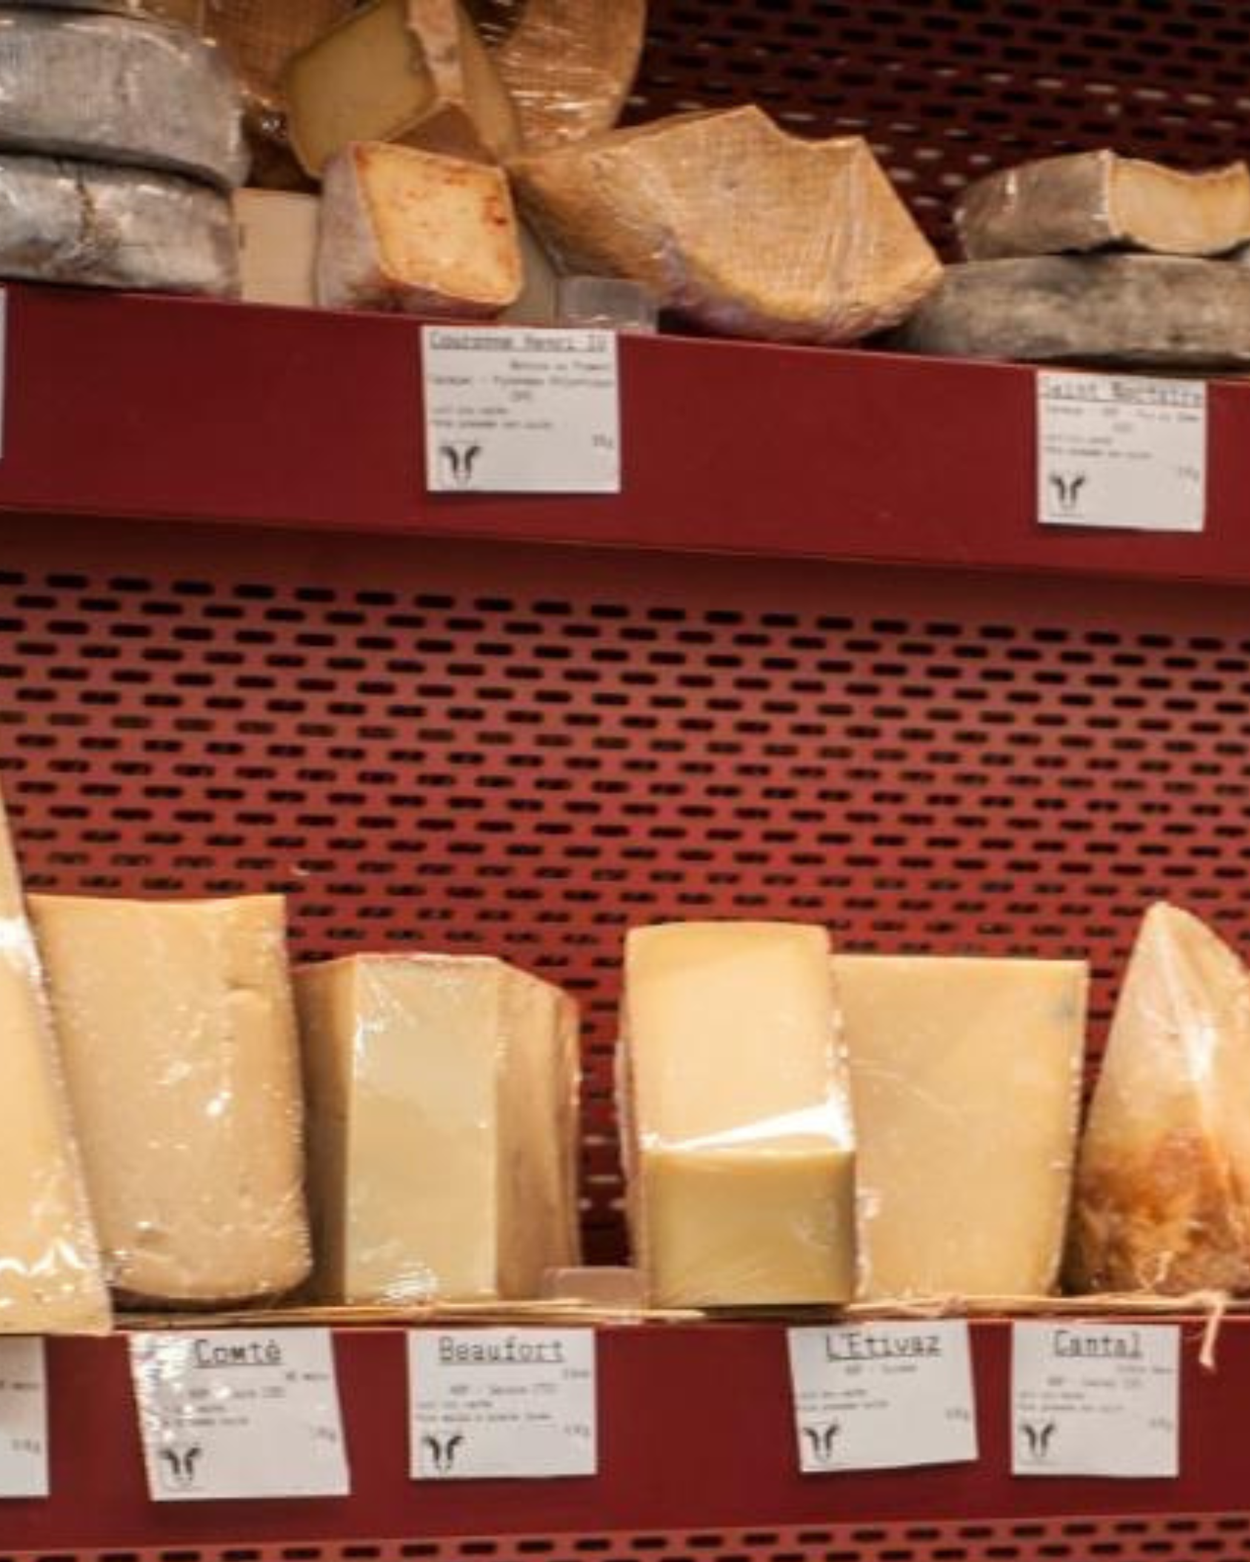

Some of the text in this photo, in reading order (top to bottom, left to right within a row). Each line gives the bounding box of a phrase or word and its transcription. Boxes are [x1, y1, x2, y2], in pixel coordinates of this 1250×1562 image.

[194, 1339, 283, 1367] Comté
[439, 1336, 564, 1363] Beaufort
[1055, 1330, 1141, 1357] Cantal
